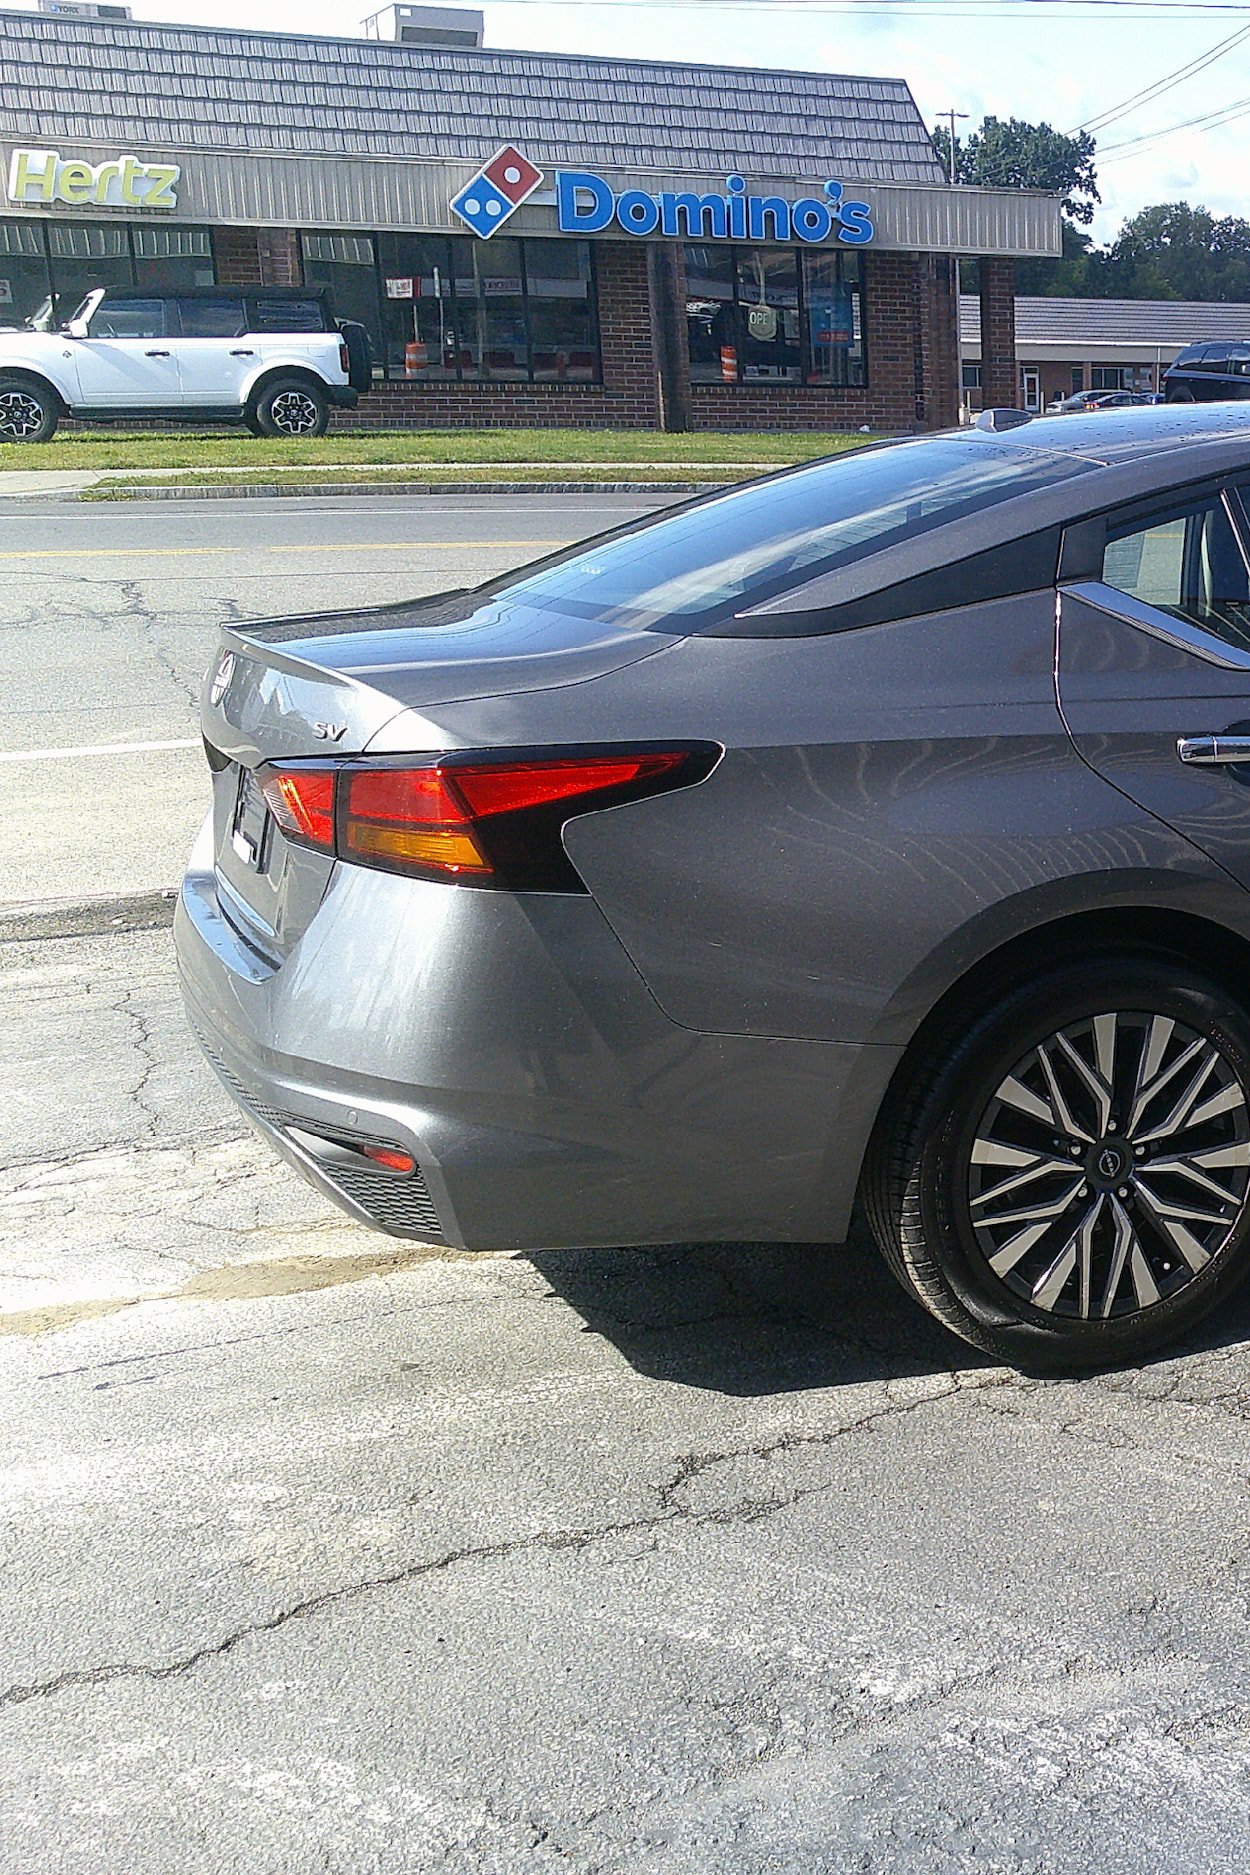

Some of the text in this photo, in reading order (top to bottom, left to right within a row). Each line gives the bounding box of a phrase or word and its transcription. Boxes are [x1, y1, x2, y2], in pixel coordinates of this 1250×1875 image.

[14, 153, 177, 206] Hertz
[556, 174, 874, 244] Domino's
[312, 721, 348, 742] SV
